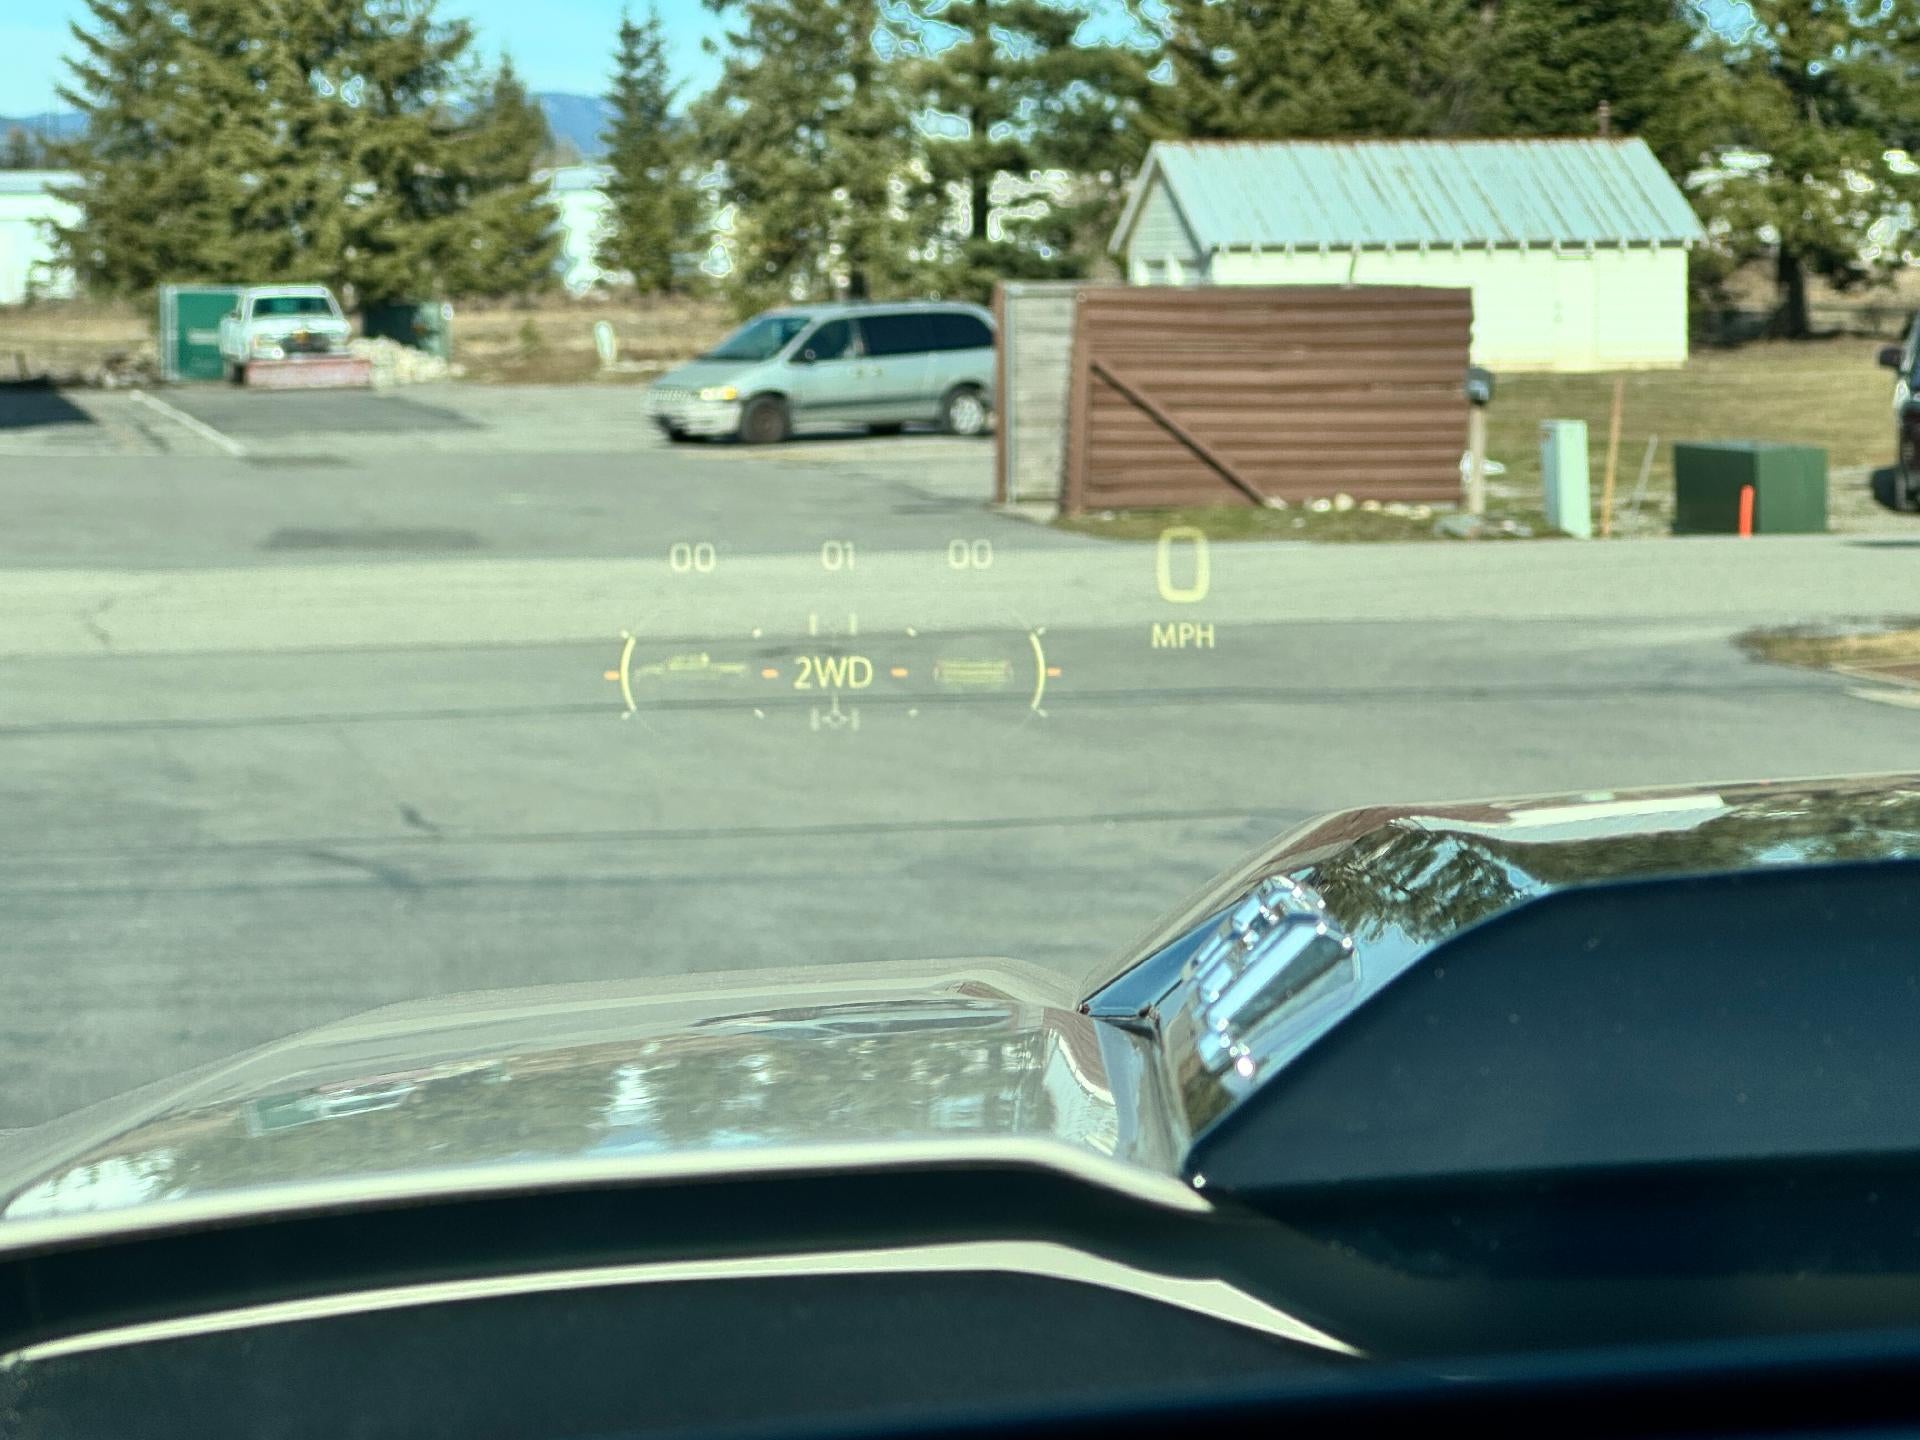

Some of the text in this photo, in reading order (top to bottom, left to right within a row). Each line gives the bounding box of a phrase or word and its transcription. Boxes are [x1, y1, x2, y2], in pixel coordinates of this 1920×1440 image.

[670, 542, 716, 572] 00
[822, 540, 854, 571] 01
[948, 539, 993, 569] 00
[1156, 526, 1211, 604] 0
[1151, 622, 1215, 648] MPH
[793, 655, 874, 690] 2WD
